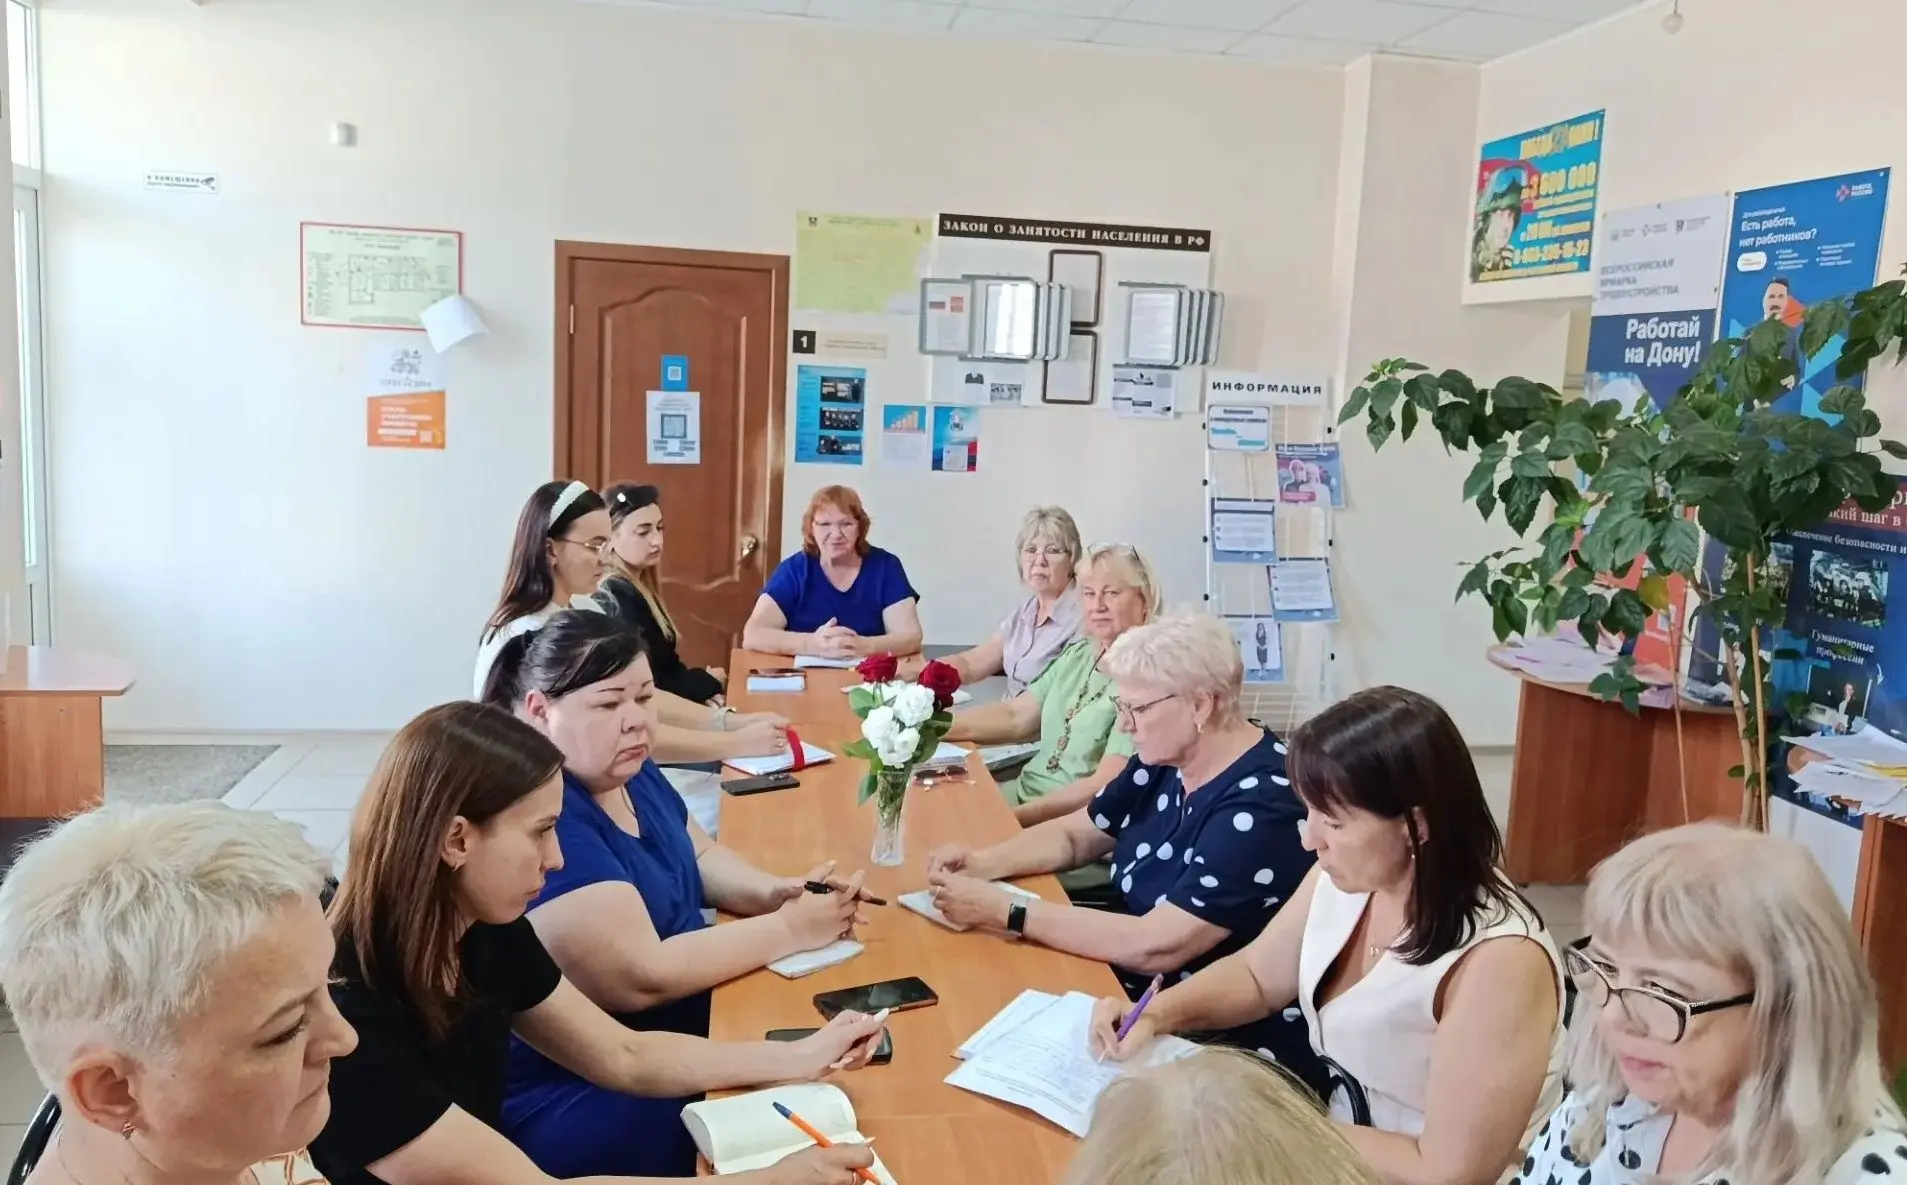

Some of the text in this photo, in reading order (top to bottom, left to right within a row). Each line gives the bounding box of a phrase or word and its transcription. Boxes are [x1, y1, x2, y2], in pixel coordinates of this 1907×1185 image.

[943, 220, 1206, 247] ЗАКОН О ЗАНЯТОСТИ НАСЕЛЕНИЯ В РФ
[1741, 216, 1797, 232] Есть работа,
[1755, 228, 1818, 248] работников?
[1626, 315, 1700, 340] Работай
[800, 335, 808, 348] 1
[1624, 340, 1701, 369] на Дону!
[1212, 381, 1322, 395] ИНФОРМАЦИЯ
[1861, 511, 1889, 525] шаг
[1892, 515, 1902, 527] в
[1834, 534, 1897, 554] безопасности
